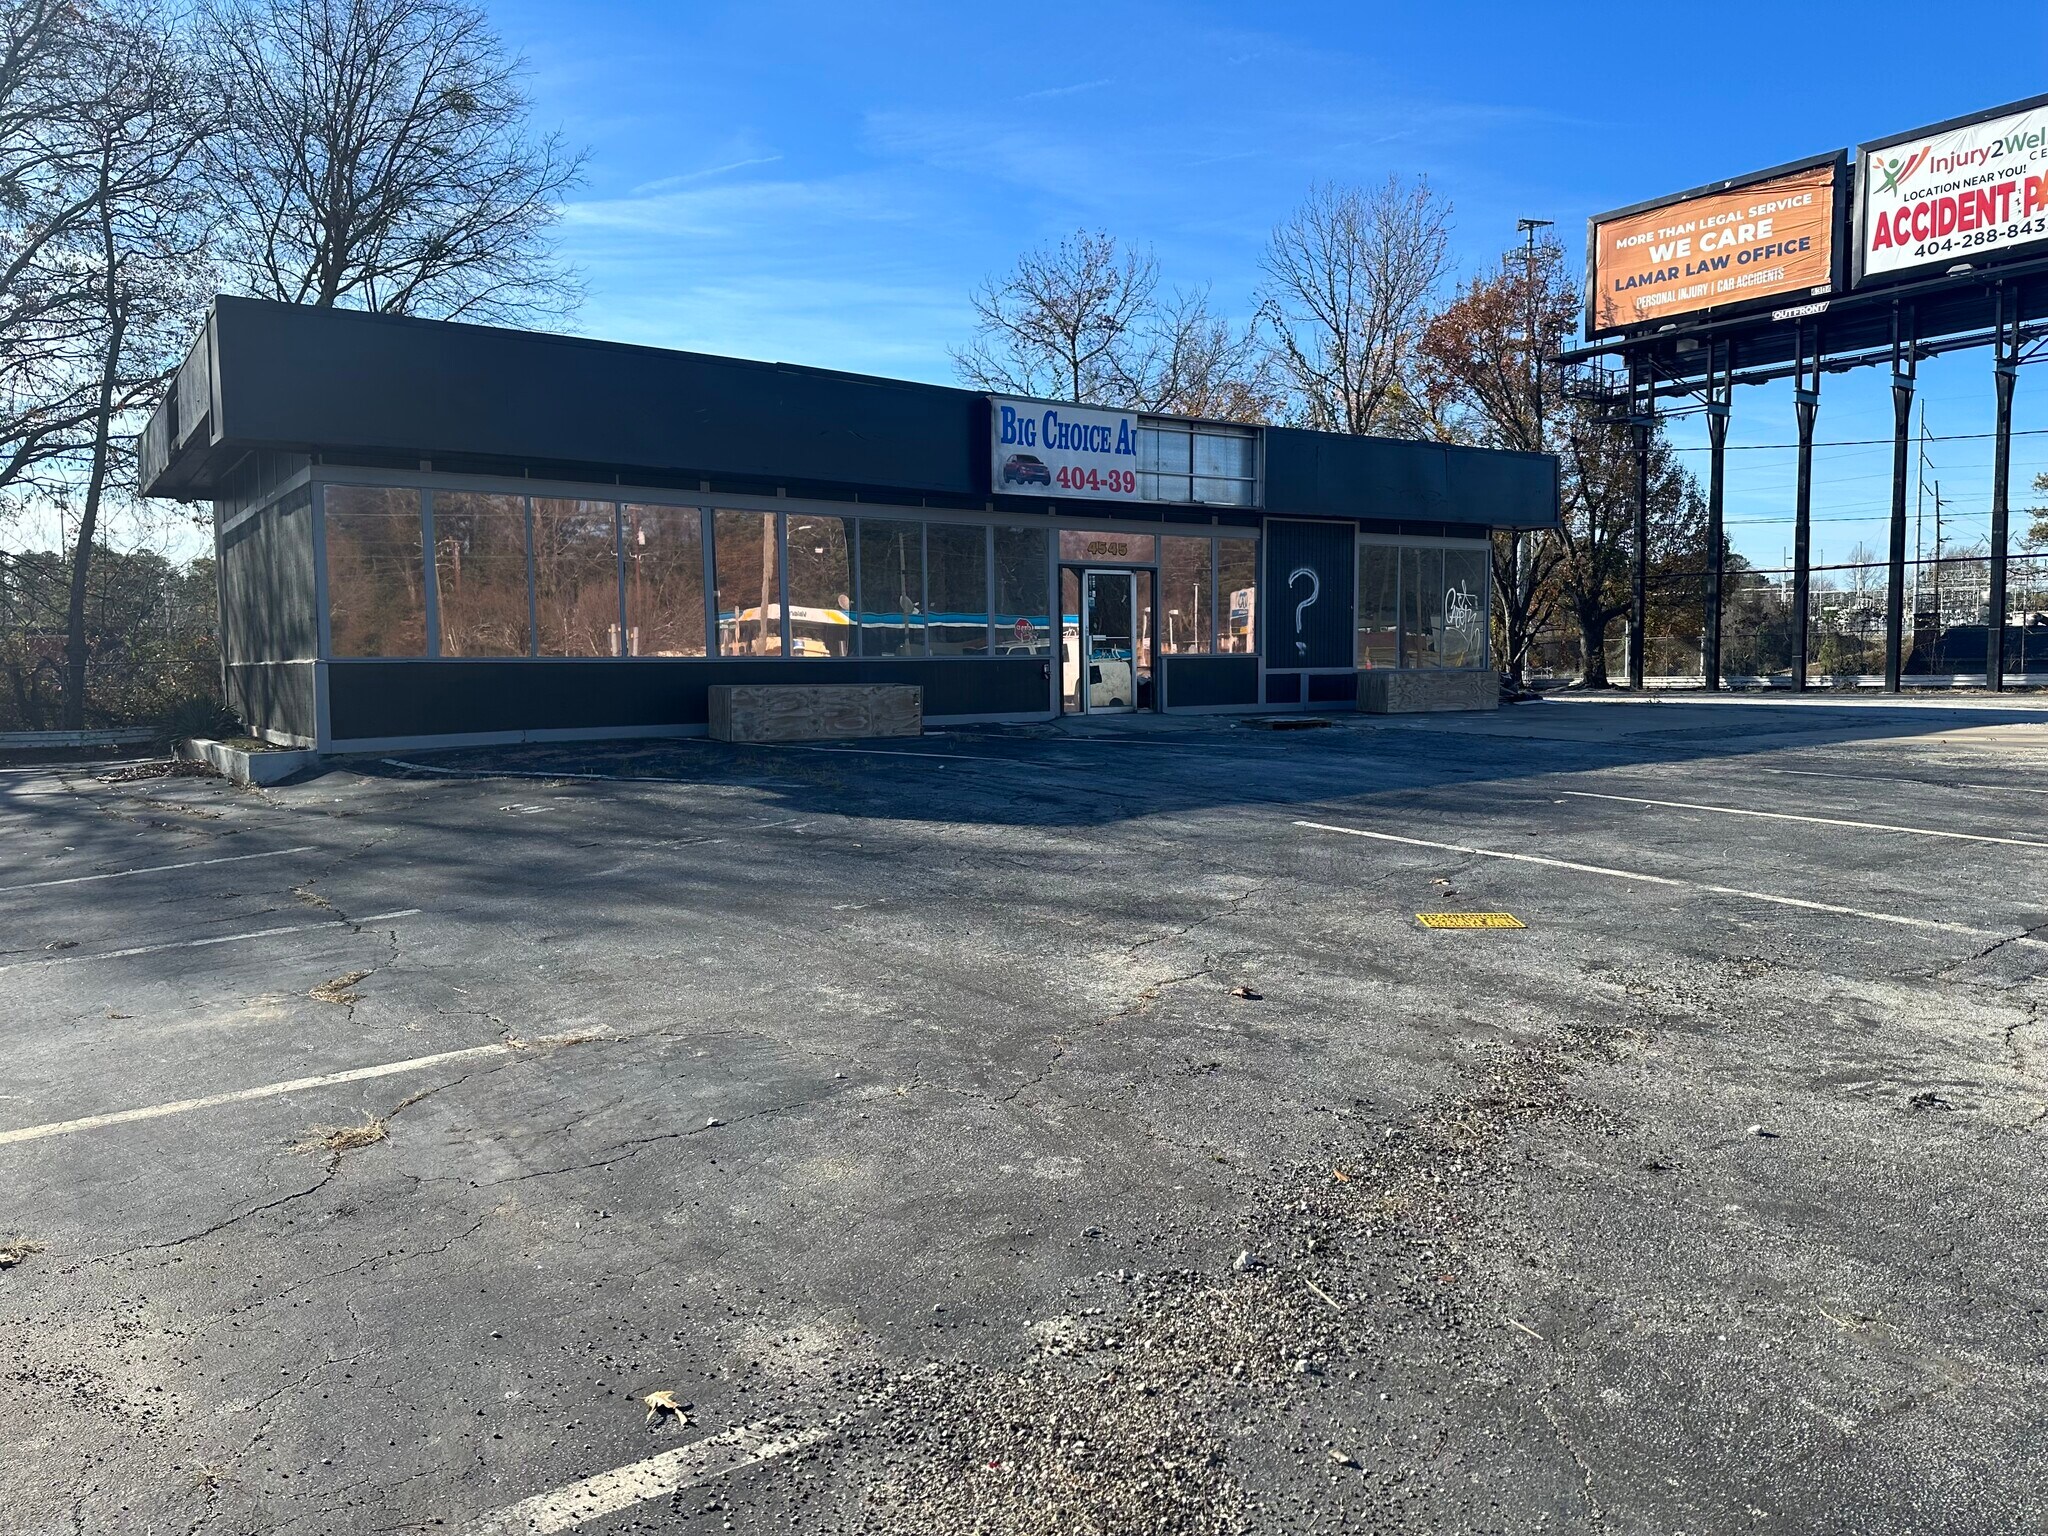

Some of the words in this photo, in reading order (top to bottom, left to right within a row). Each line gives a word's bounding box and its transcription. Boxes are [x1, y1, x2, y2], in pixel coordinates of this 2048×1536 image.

[1930, 127, 2048, 174] Injury2Wel
[1903, 181, 1960, 202] LOCATION
[1963, 172, 1995, 192] NEAR
[1997, 164, 2027, 180] YOU!
[1616, 231, 1654, 250] MORE
[1657, 221, 1696, 240] THAN
[1699, 211, 1744, 230] LEGAL
[1748, 193, 1813, 218] SERVICE
[1872, 181, 2016, 251] ACCIDENT
[1914, 218, 2048, 257] 404-288-843
[1648, 238, 1691, 264] WE
[1699, 218, 1773, 251] CARE
[1615, 266, 1679, 292] LAMAR
[1685, 254, 1731, 277] LAW
[1737, 236, 1811, 265] OFFICE
[1636, 289, 1676, 310] PERSONAL
[1678, 283, 1709, 301] INJURY
[1717, 278, 1735, 293] CAR
[1736, 267, 1786, 289] ACCIDENTS
[1773, 303, 1827, 319] OUTFRONT
[1056, 466, 1136, 494] 404-39
[1087, 541, 1128, 556] 4545
